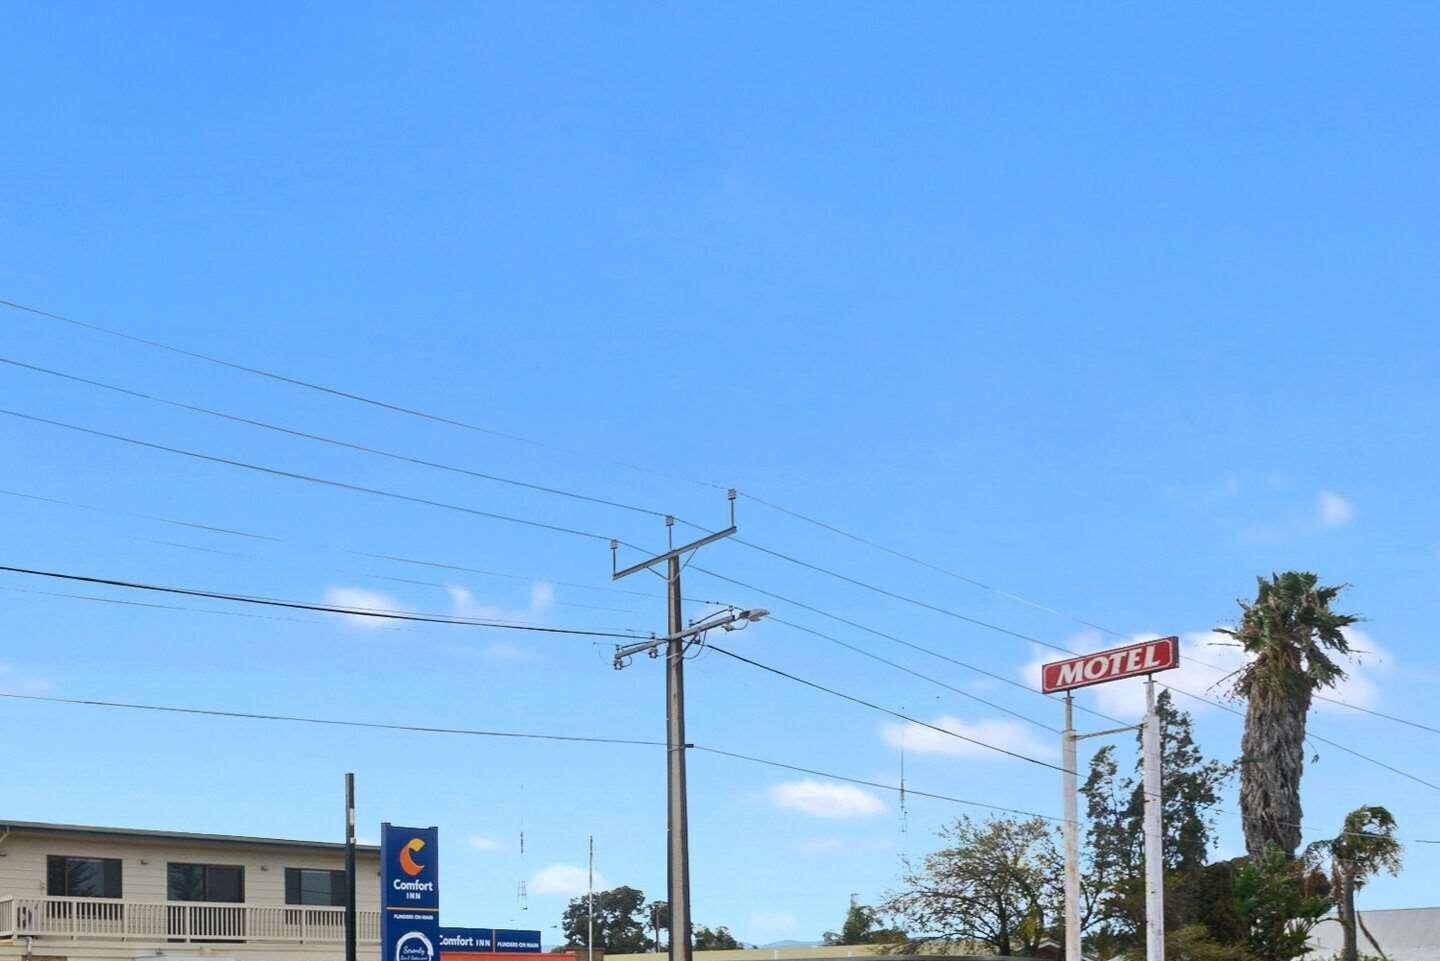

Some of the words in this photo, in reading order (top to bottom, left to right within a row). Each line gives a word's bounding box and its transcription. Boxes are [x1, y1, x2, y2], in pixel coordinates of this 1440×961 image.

[1055, 644, 1161, 687] MOTEL
[393, 878, 434, 892] Comfort
[406, 892, 421, 900] INN
[475, 938, 491, 947] INN
